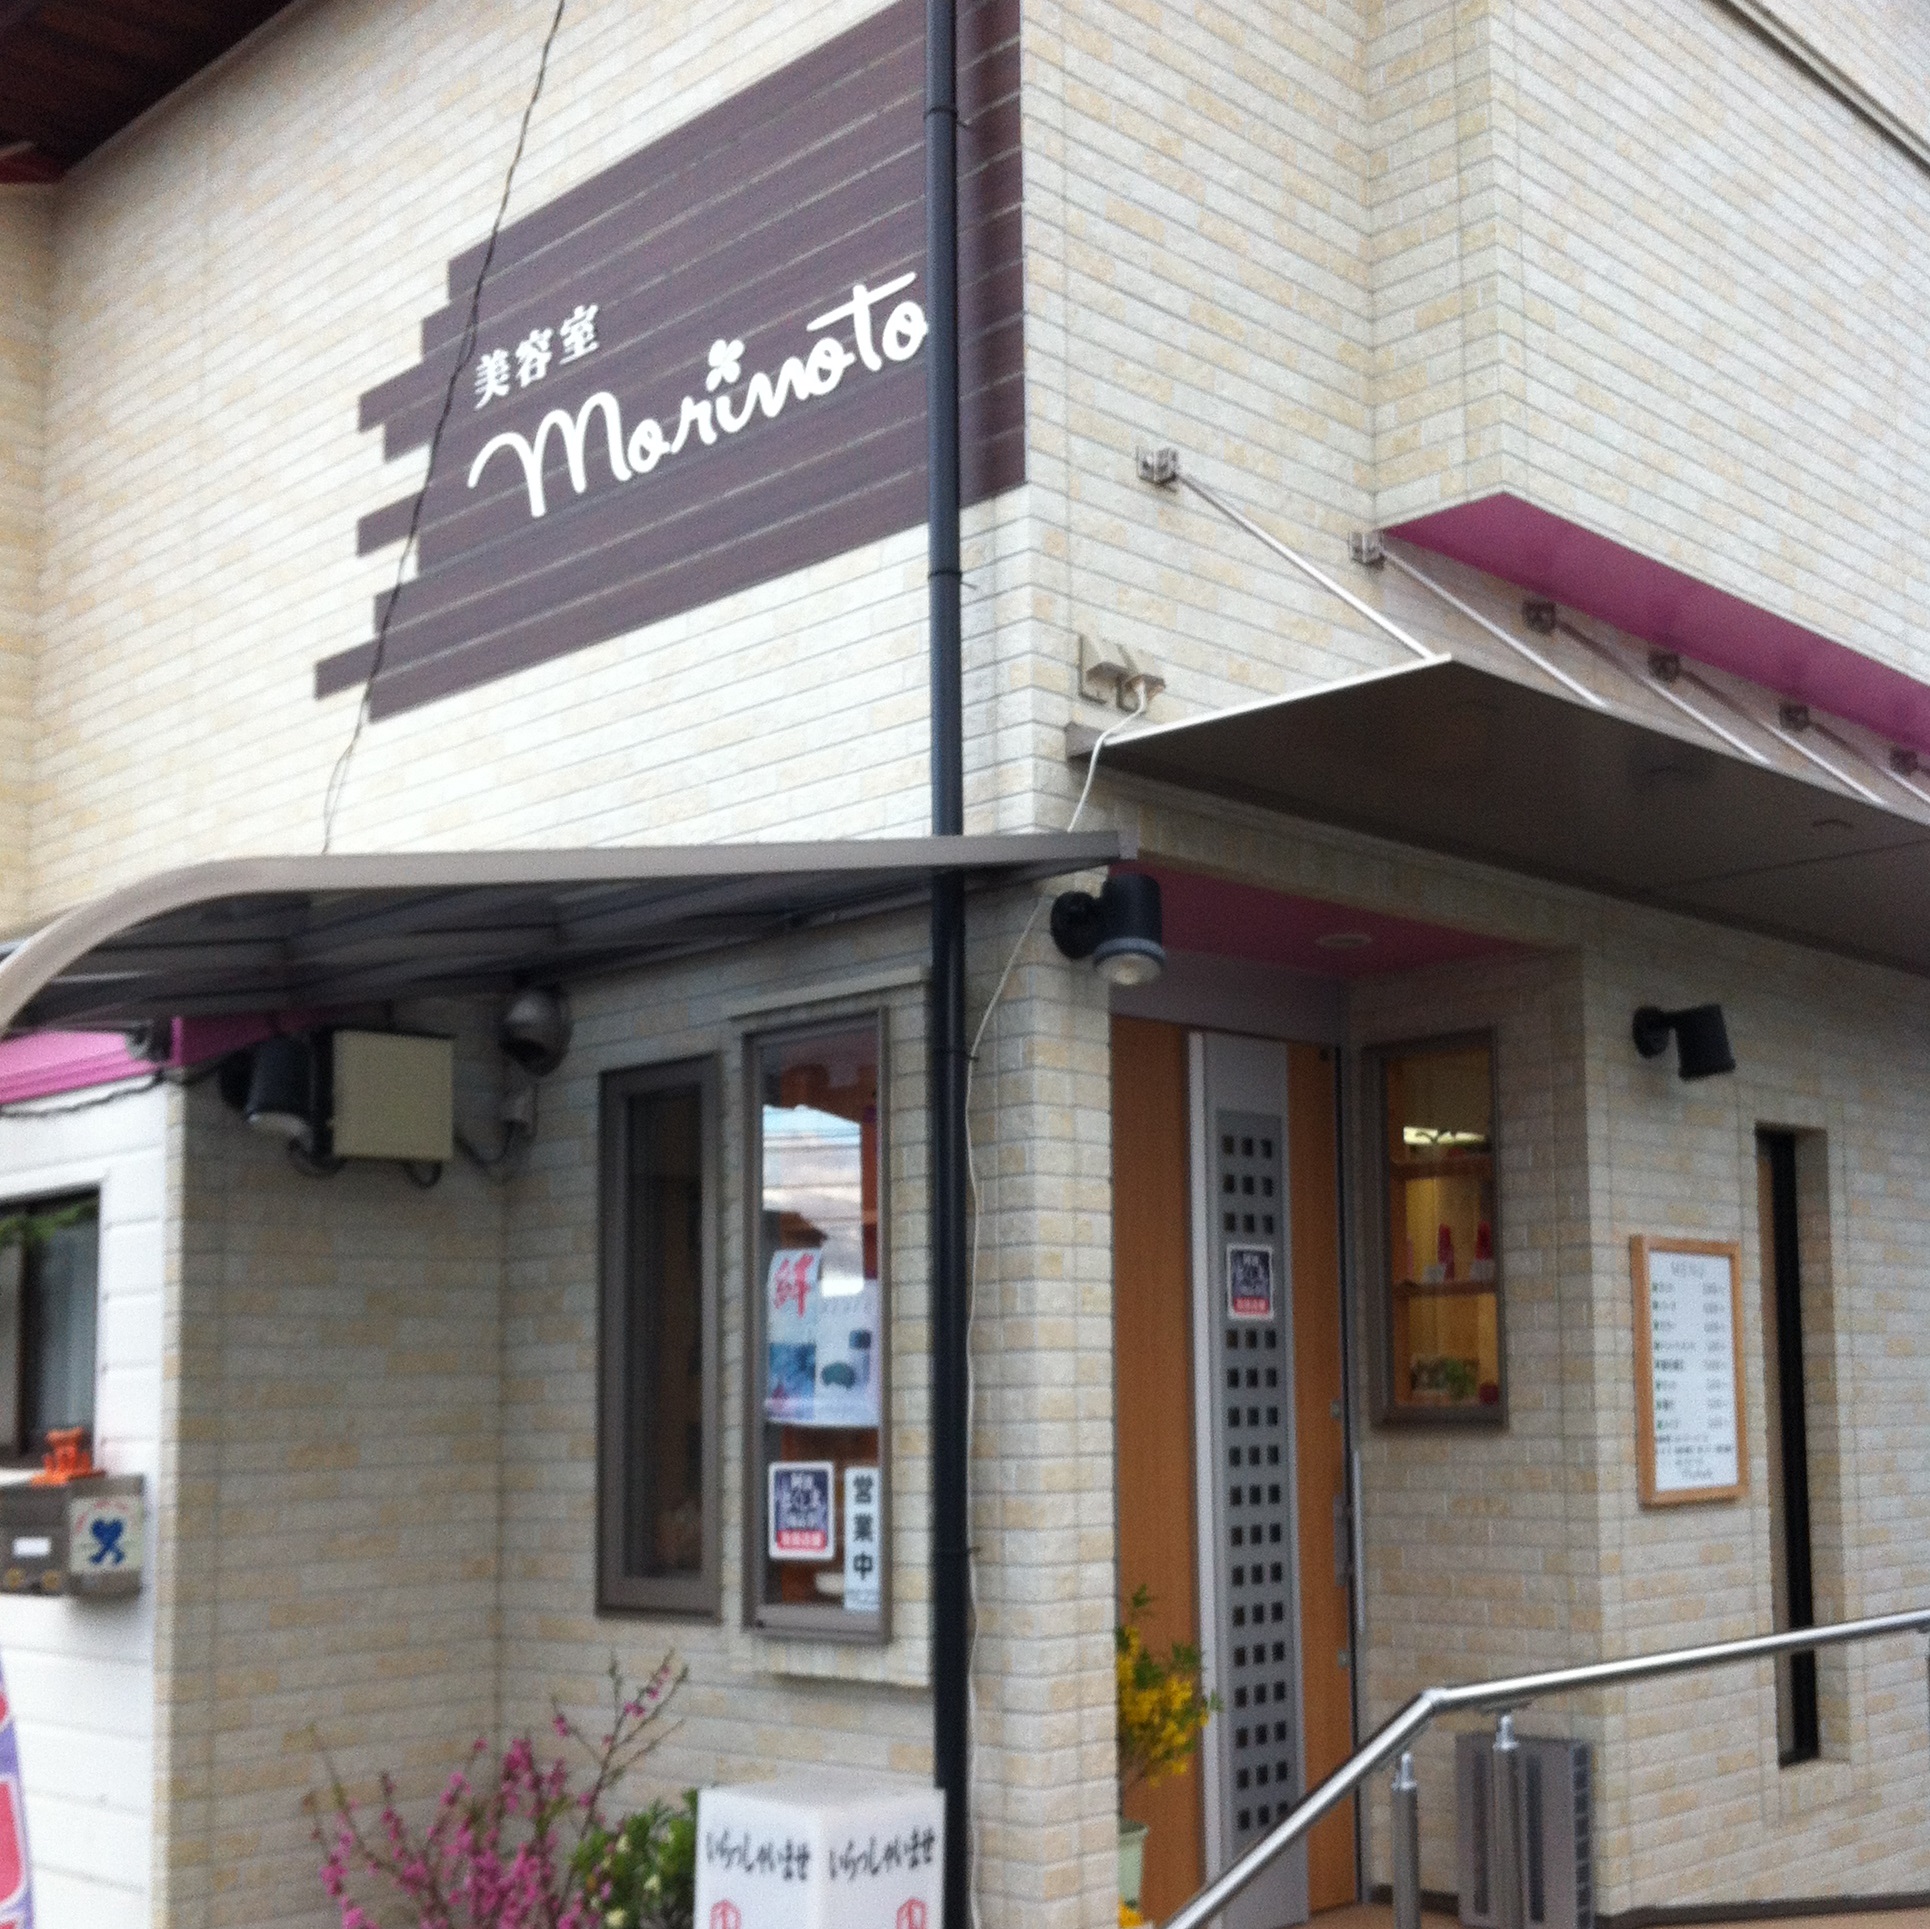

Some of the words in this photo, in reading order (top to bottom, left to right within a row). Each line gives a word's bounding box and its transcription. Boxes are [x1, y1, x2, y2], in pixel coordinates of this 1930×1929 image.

[467, 271, 928, 518] Morimoto
[475, 304, 599, 409] 美容室
[853, 1475, 873, 1581] 営業中
